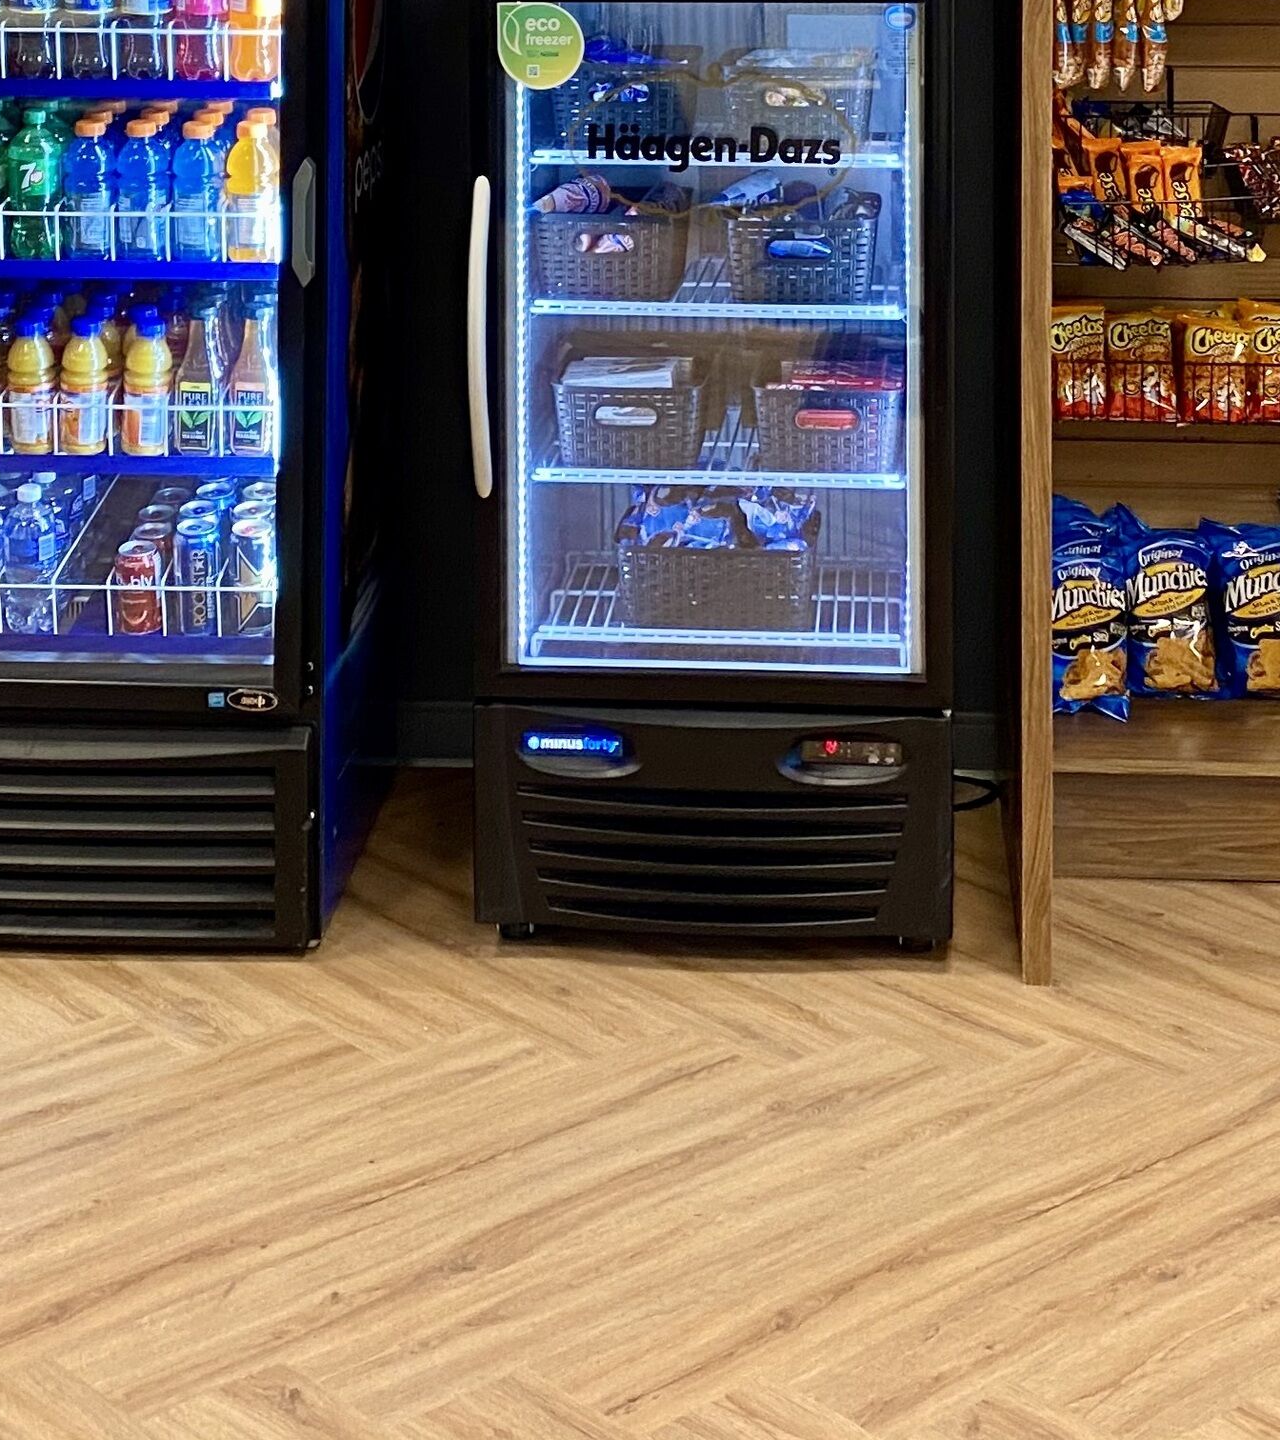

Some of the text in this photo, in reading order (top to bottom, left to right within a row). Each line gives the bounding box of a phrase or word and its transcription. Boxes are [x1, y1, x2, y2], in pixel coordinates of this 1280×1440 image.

[524, 17, 561, 32] eco
[524, 33, 574, 46] freezer
[586, 122, 842, 173] Häagen-Dazs
[354, 139, 384, 215] peps
[182, 391, 207, 401] PURE
[191, 549, 207, 627] ROCSTAR
[1126, 563, 1208, 610] Munchie
